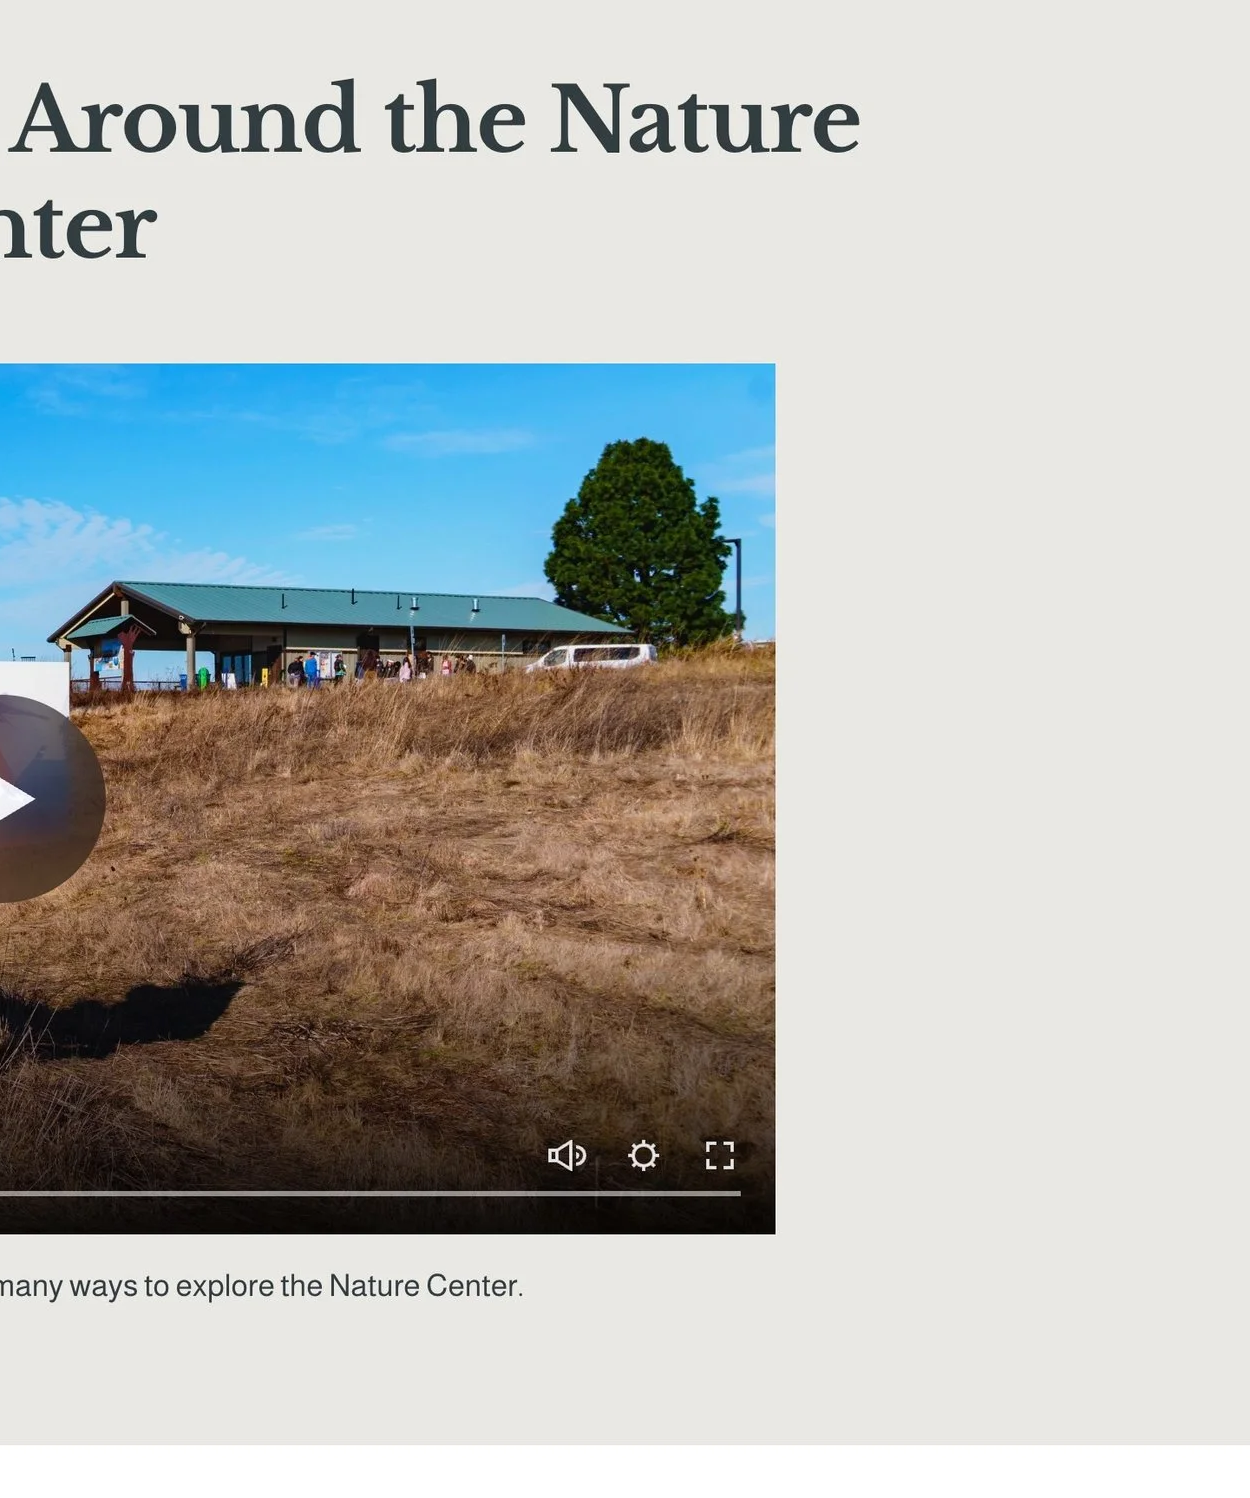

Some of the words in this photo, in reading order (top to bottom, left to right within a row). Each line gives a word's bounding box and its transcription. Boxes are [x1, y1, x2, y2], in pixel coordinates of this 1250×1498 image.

[7, 77, 362, 154] Around
[384, 77, 526, 154] the
[550, 83, 860, 154] Nature
[69, 1279, 138, 1303] ways
[143, 1275, 169, 1297] to
[176, 1273, 274, 1304] explore
[280, 1273, 323, 1297] the
[330, 1273, 420, 1297] Nature
[427, 1273, 523, 1297] Center.
